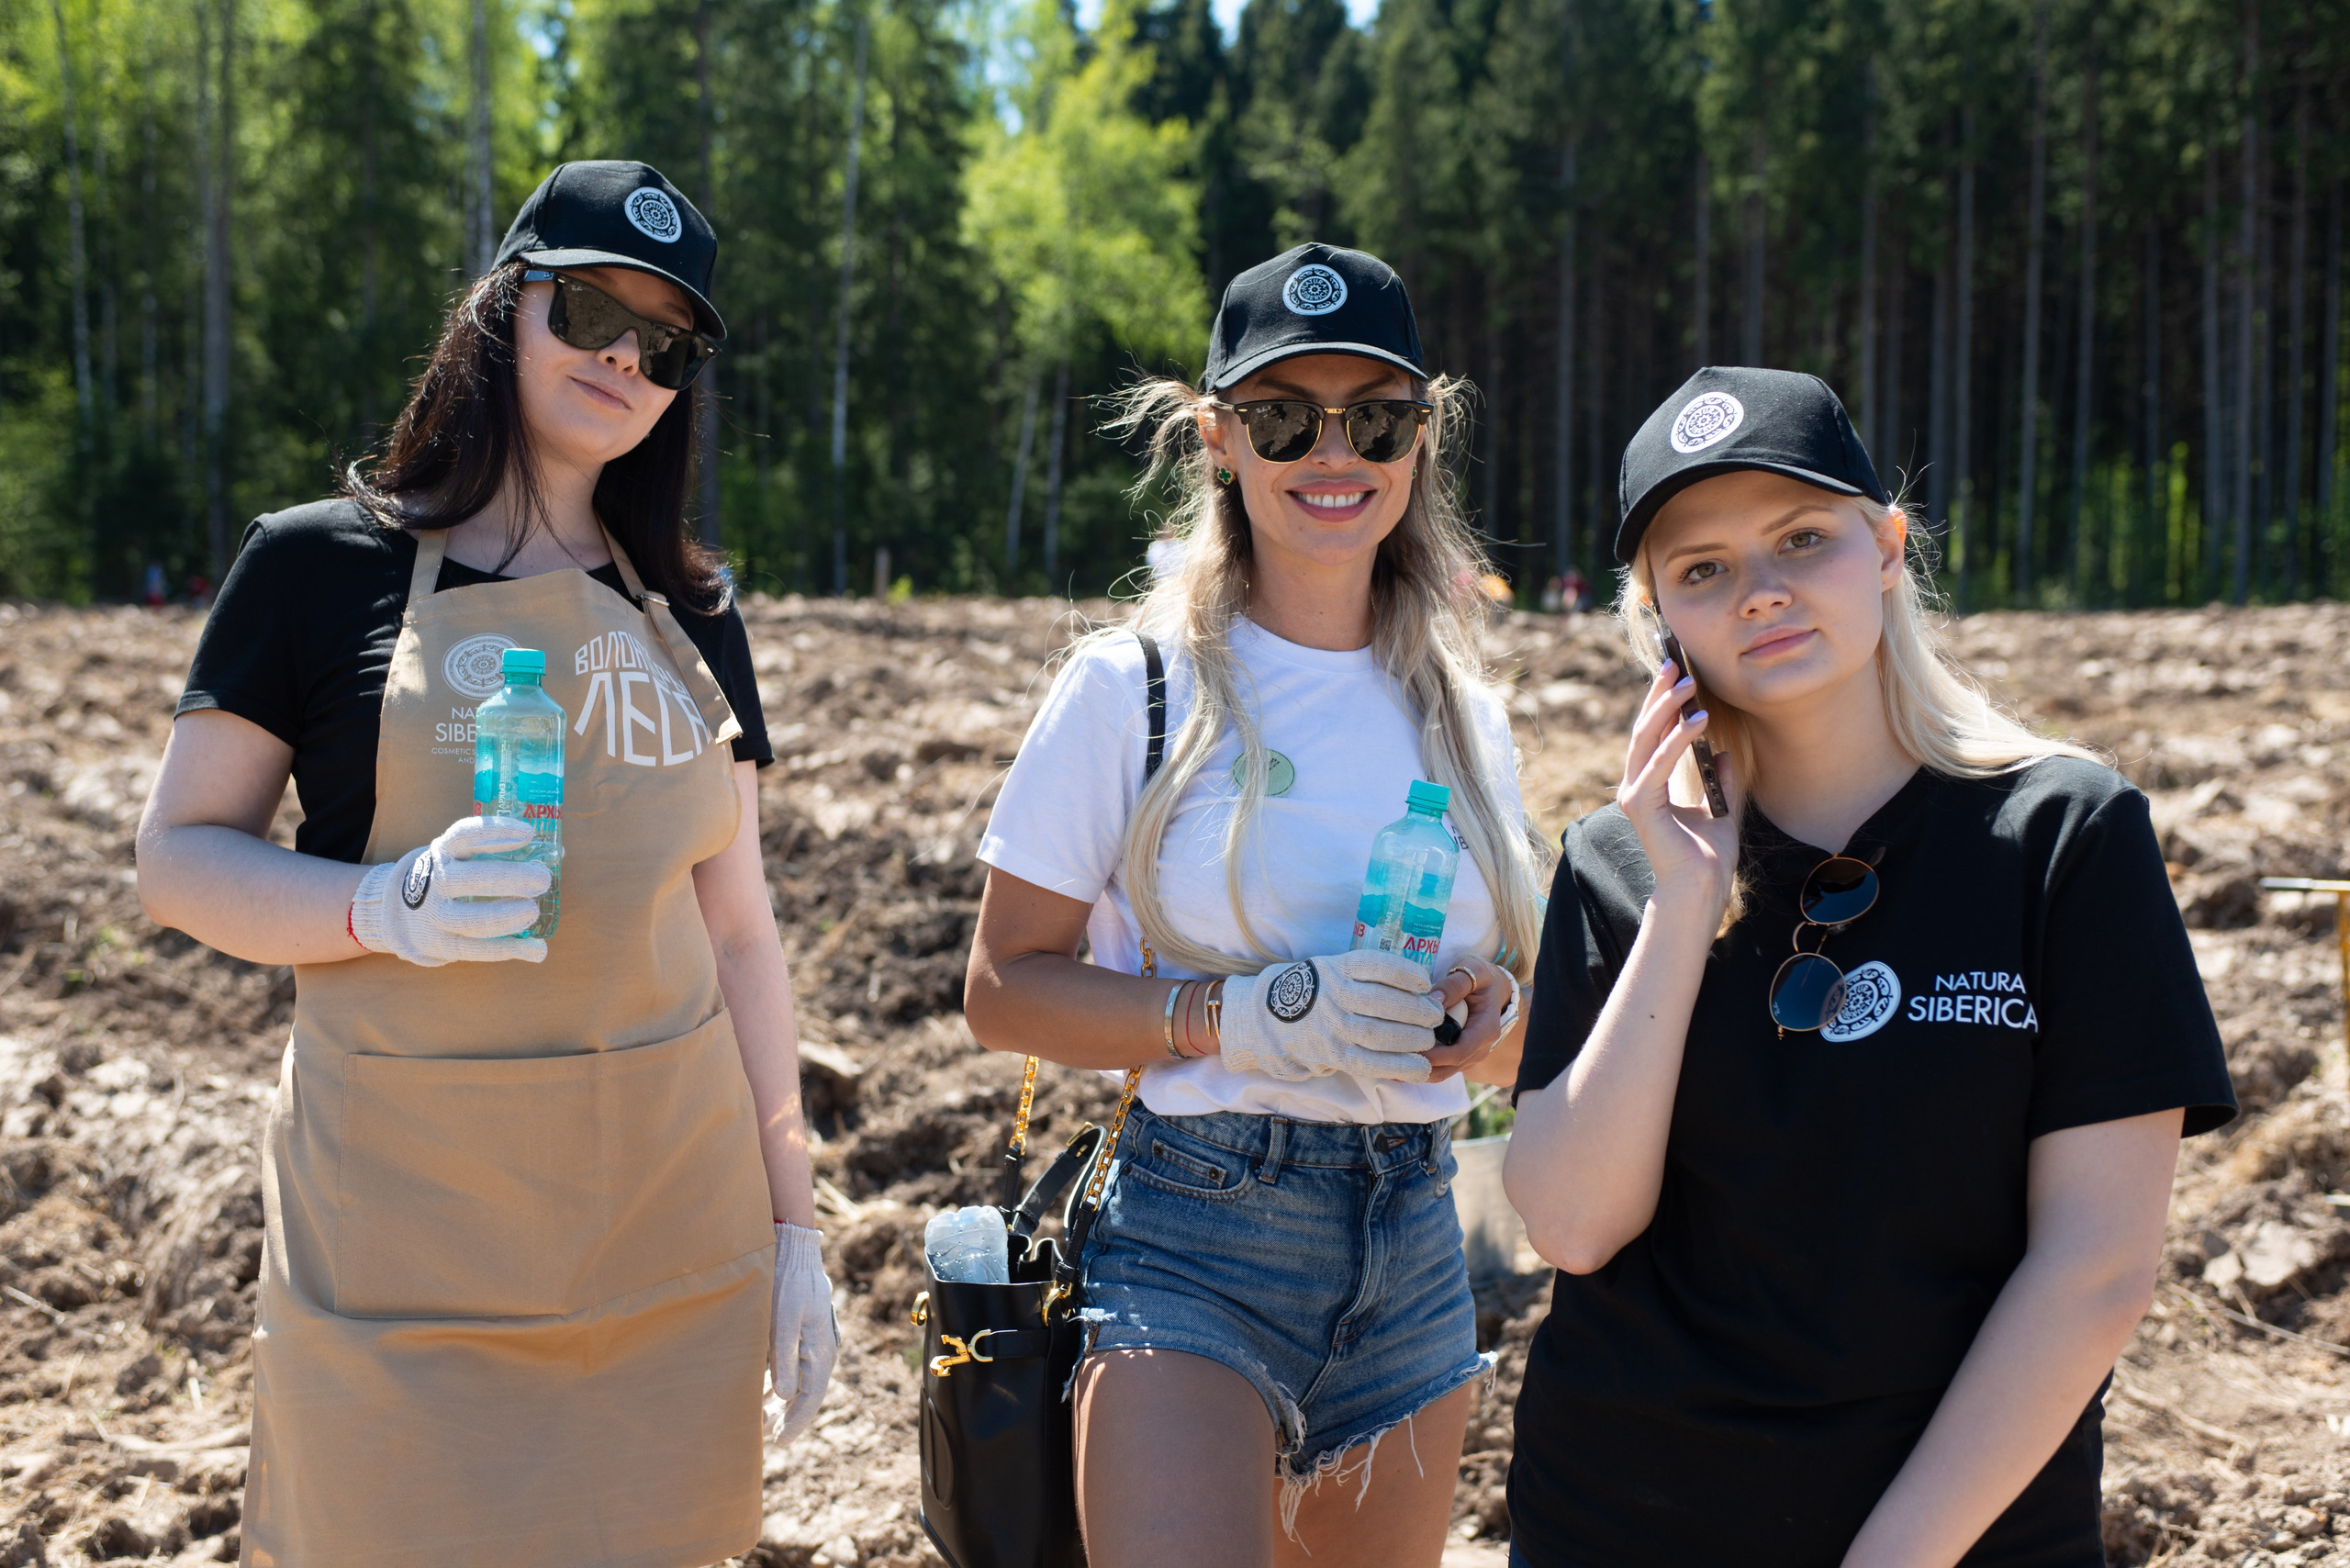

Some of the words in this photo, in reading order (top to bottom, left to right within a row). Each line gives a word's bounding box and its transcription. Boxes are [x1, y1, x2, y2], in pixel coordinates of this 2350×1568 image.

[575, 631, 690, 697] ВОЛОНРЫ
[574, 672, 711, 767] ЛЕСА
[435, 722, 476, 743] SIBE
[523, 804, 563, 819] АРХЫ
[1404, 936, 1441, 954] АРХЫ
[1935, 971, 2026, 994] NATURA
[1908, 995, 2038, 1034] SIBERICA
